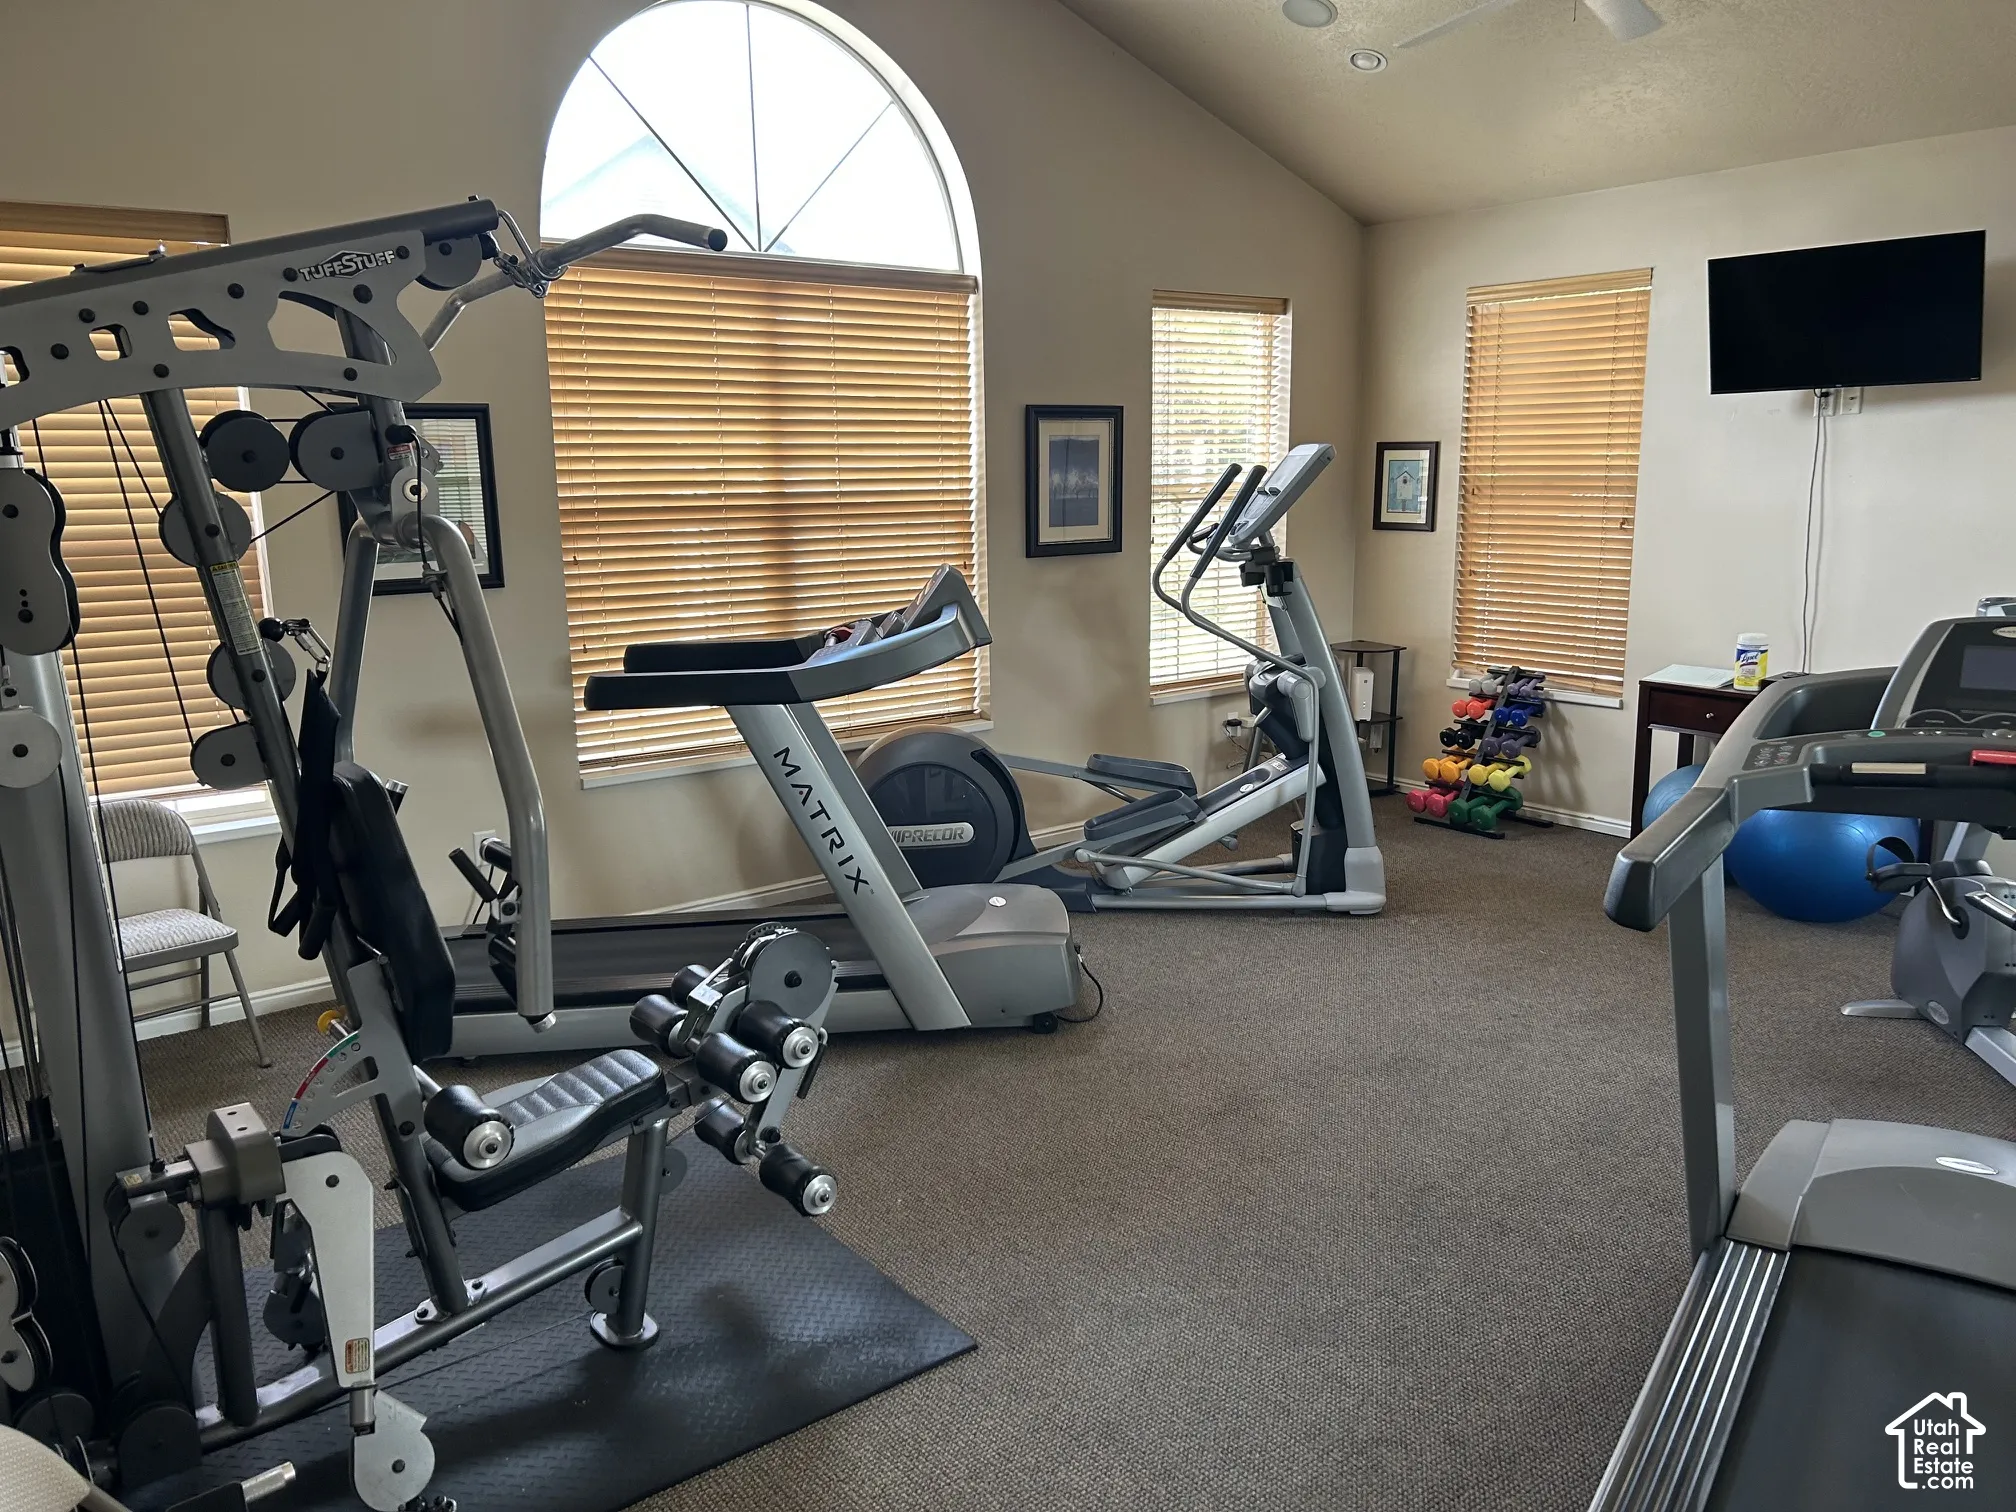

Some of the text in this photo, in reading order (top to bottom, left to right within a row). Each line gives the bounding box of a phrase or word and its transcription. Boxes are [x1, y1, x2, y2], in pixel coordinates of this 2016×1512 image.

[299, 250, 395, 281] TUFFSTUFF
[773, 746, 870, 895] MATRIX
[900, 827, 964, 843] PRECOR
